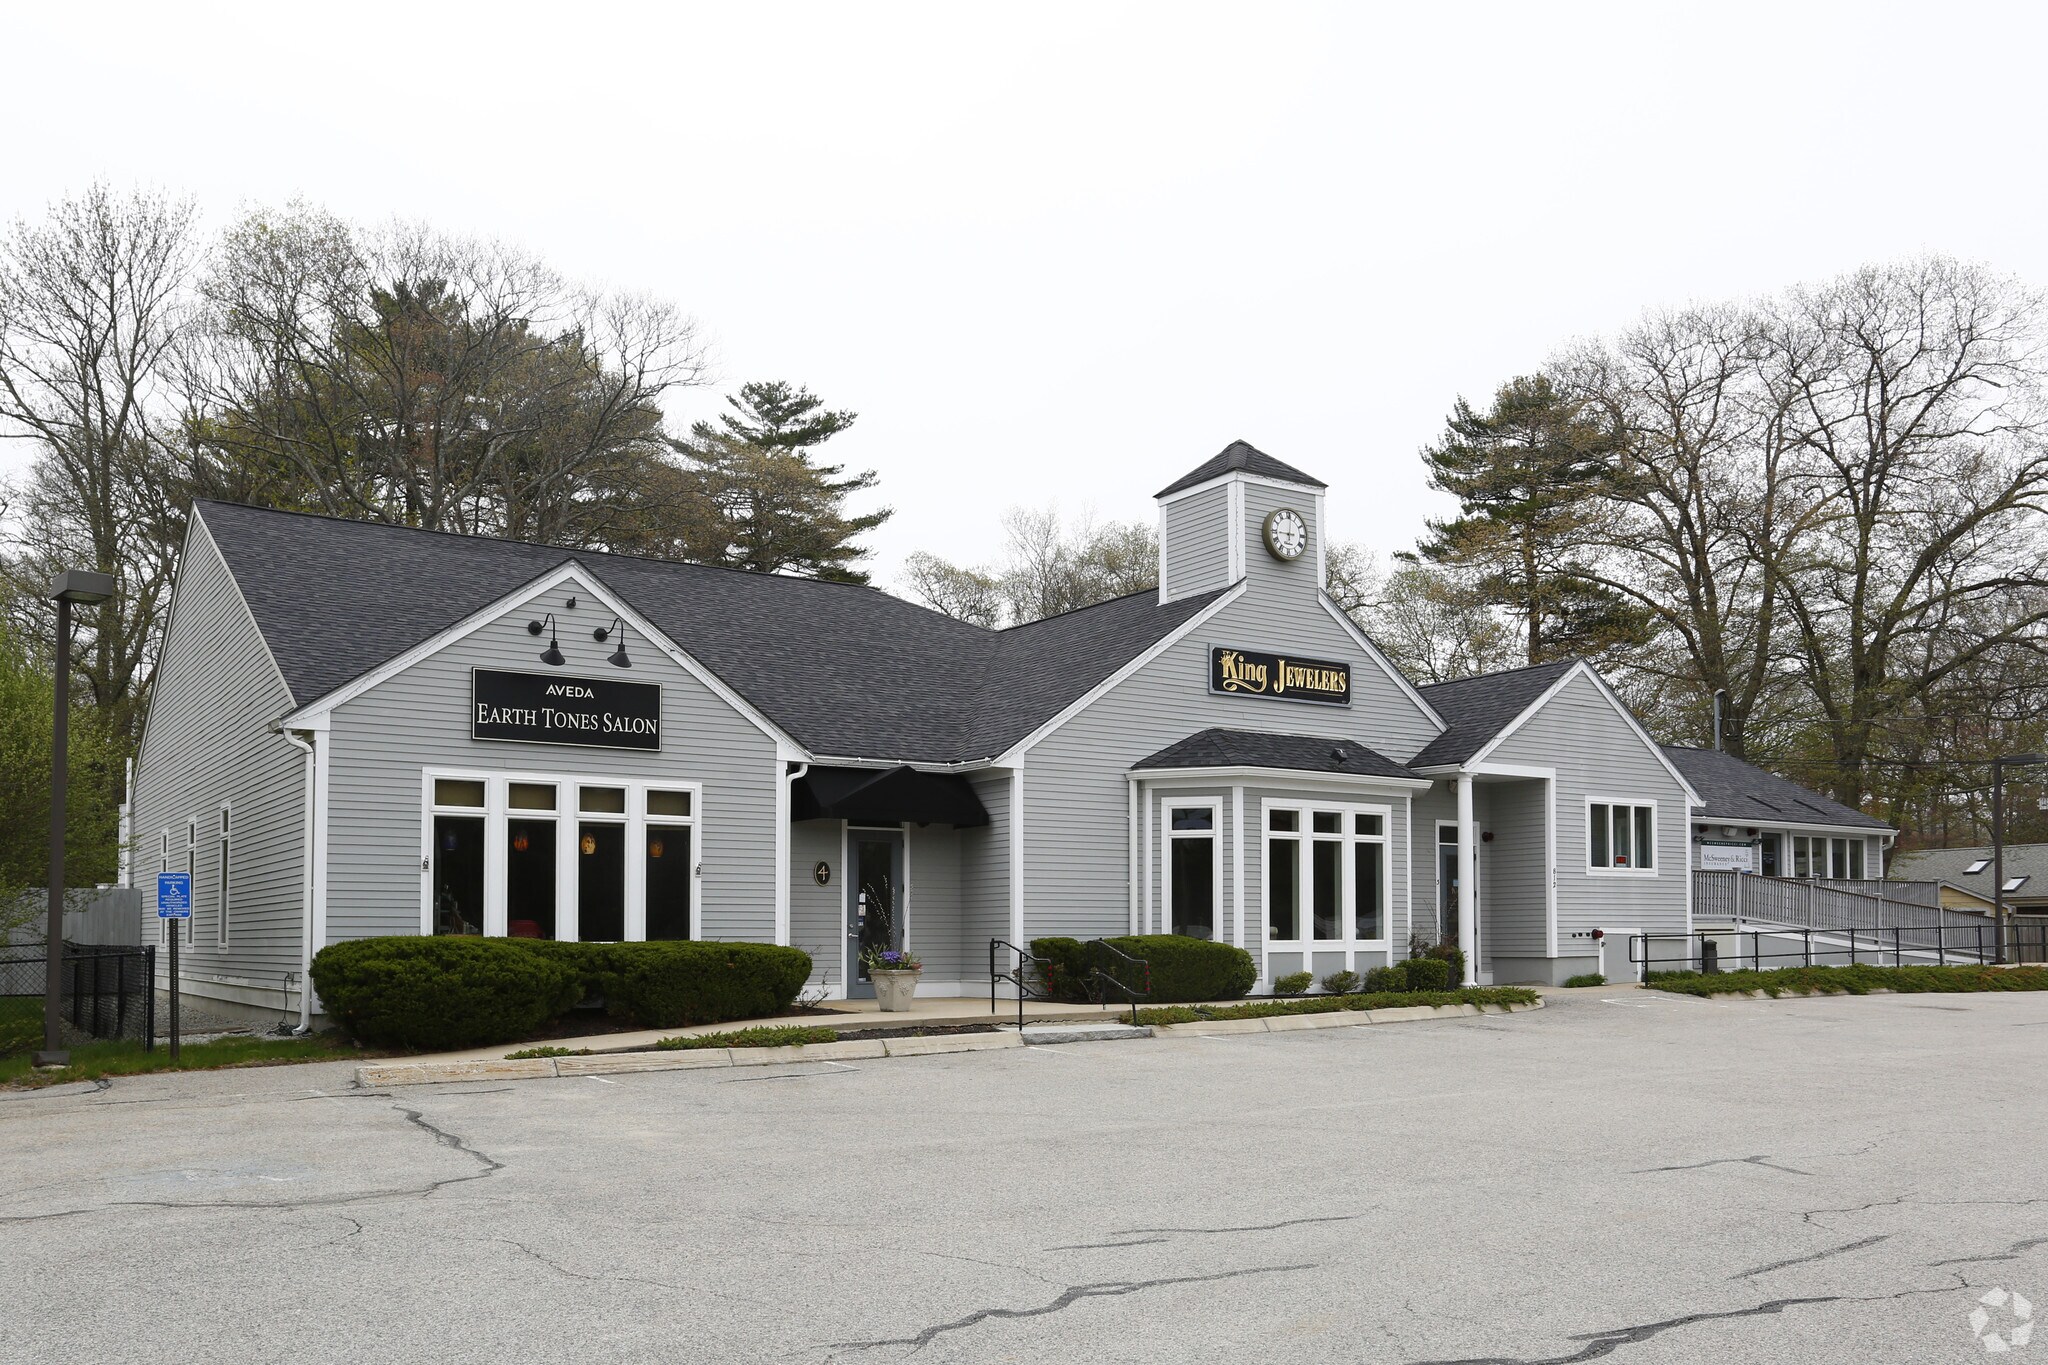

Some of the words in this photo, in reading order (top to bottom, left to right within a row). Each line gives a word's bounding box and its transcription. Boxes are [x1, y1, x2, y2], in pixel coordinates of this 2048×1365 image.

[1219, 650, 1268, 693] King
[1273, 659, 1347, 694] JEWELERS
[545, 684, 595, 699] AVEDA
[476, 703, 537, 726] EARTH
[541, 707, 599, 731] TONES
[602, 712, 658, 735] SALON
[1703, 854, 1730, 864] McSweeney
[817, 865, 829, 881] 4
